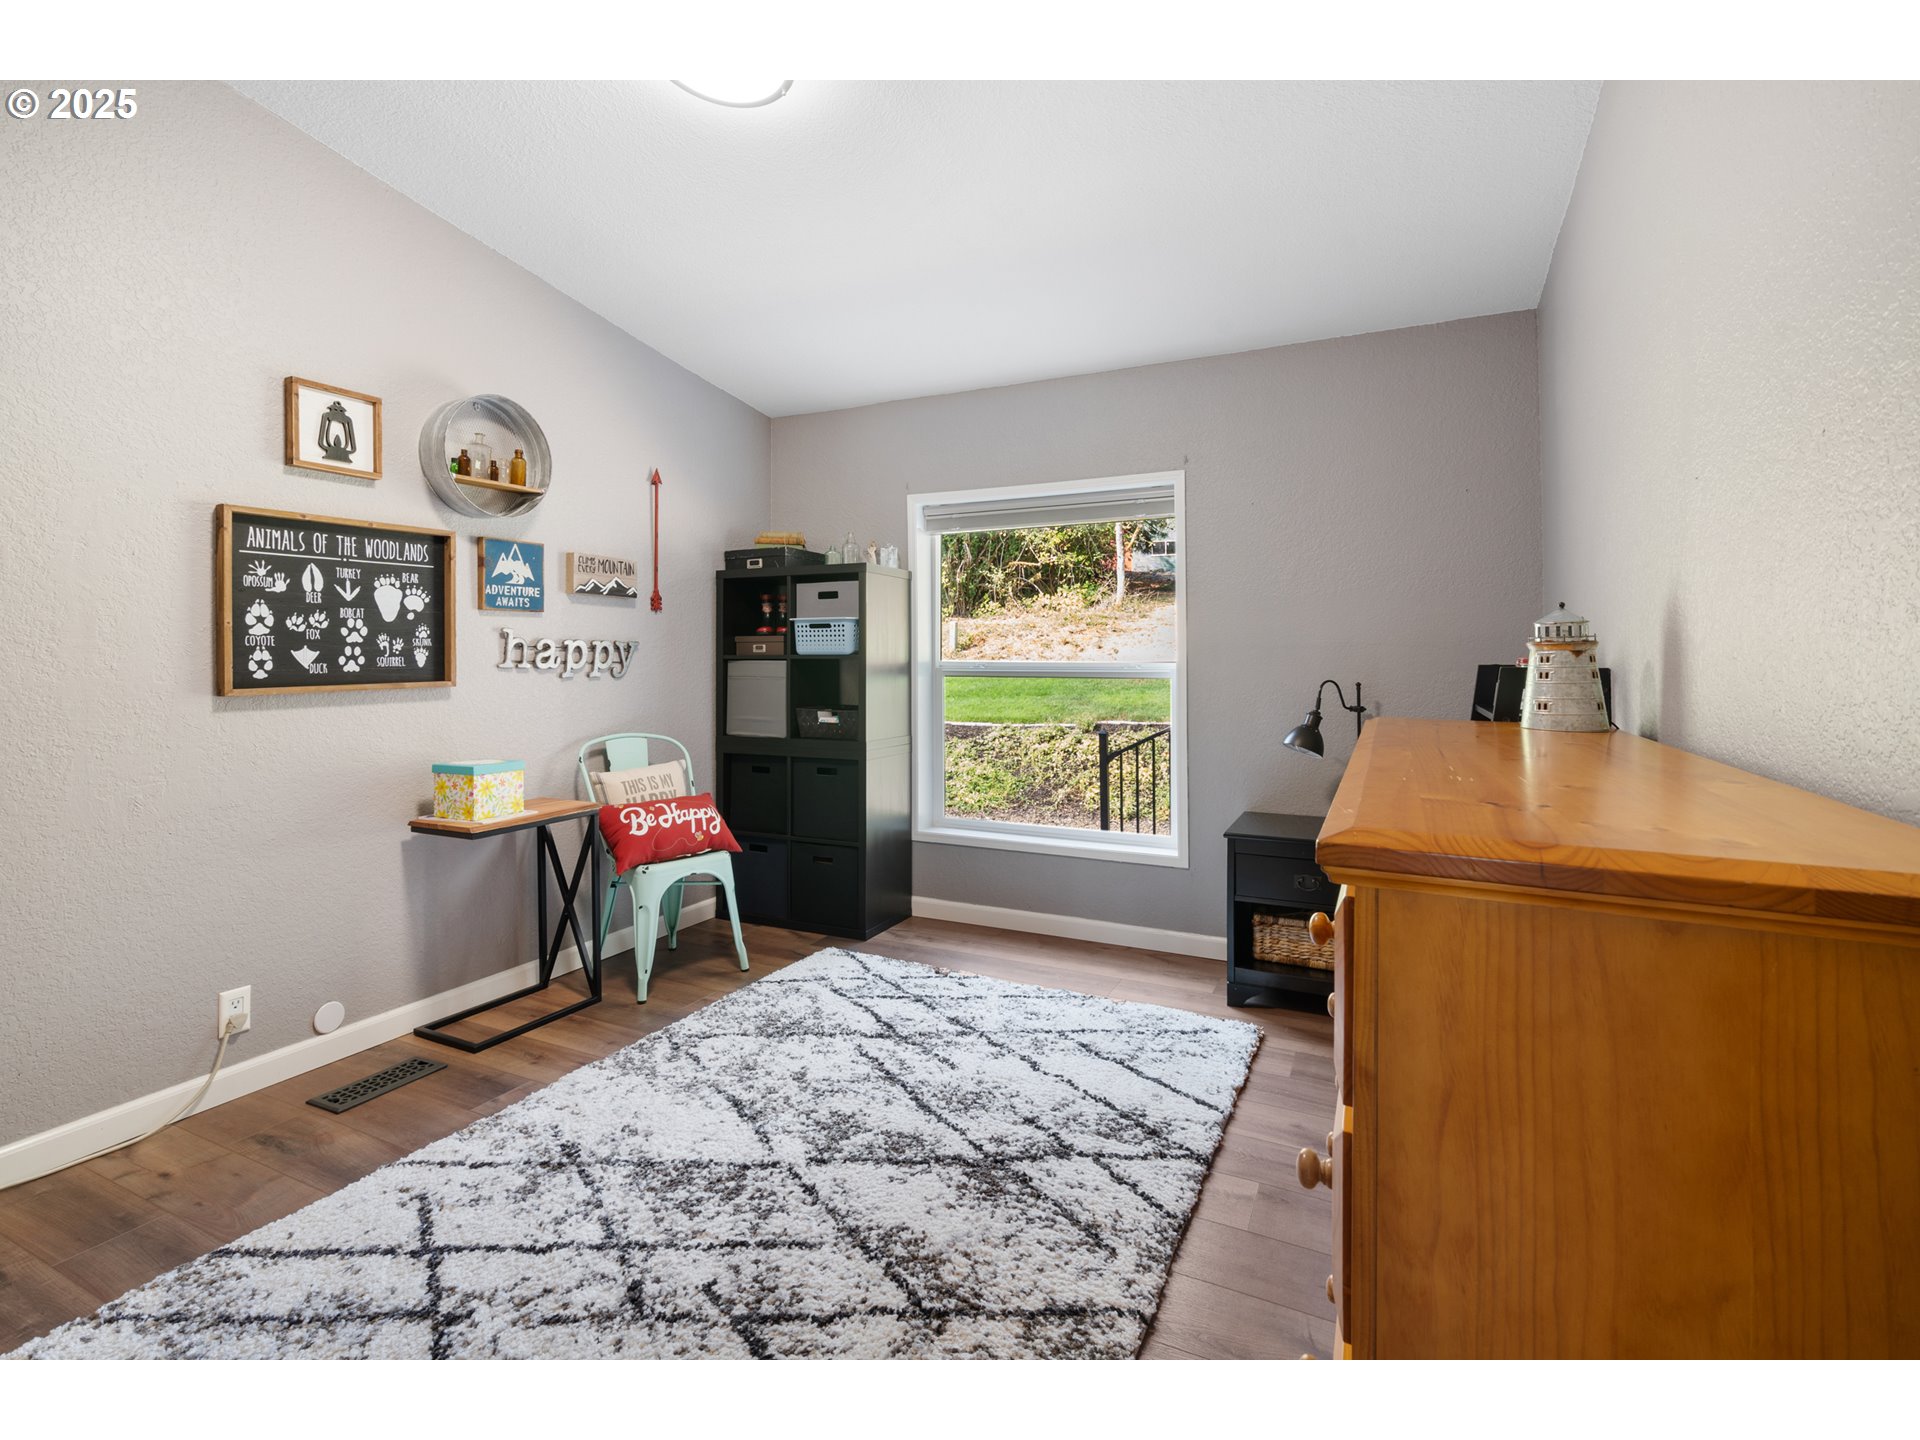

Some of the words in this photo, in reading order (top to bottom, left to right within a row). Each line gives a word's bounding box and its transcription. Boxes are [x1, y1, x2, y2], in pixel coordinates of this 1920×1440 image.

[246, 526, 306, 552] ANIMALS
[313, 533, 328, 554] OF
[336, 535, 358, 558] THE
[364, 538, 429, 563] WOODLANDS
[578, 555, 596, 565] CLIMB
[336, 567, 361, 579] TURKEY
[577, 564, 597, 574] EVERY
[597, 560, 635, 576] MOUNTAIN
[243, 575, 274, 588] OPOSSUM
[402, 573, 419, 584] BEAR
[485, 584, 541, 598] ADVENTURE
[305, 592, 322, 604] DEER
[495, 596, 531, 608] AWAITS
[340, 607, 364, 619] BOBCAT
[306, 628, 321, 640] FOX
[245, 635, 275, 647] COYOTE
[412, 638, 432, 647] SKUNK
[498, 627, 640, 679] happy
[376, 656, 406, 667] SQUIRREL
[309, 663, 328, 674] DUCK
[621, 777, 647, 796] THIS
[646, 775, 659, 791] IS
[659, 773, 675, 789] MY
[620, 806, 657, 836] Be
[655, 802, 721, 835] Happy
